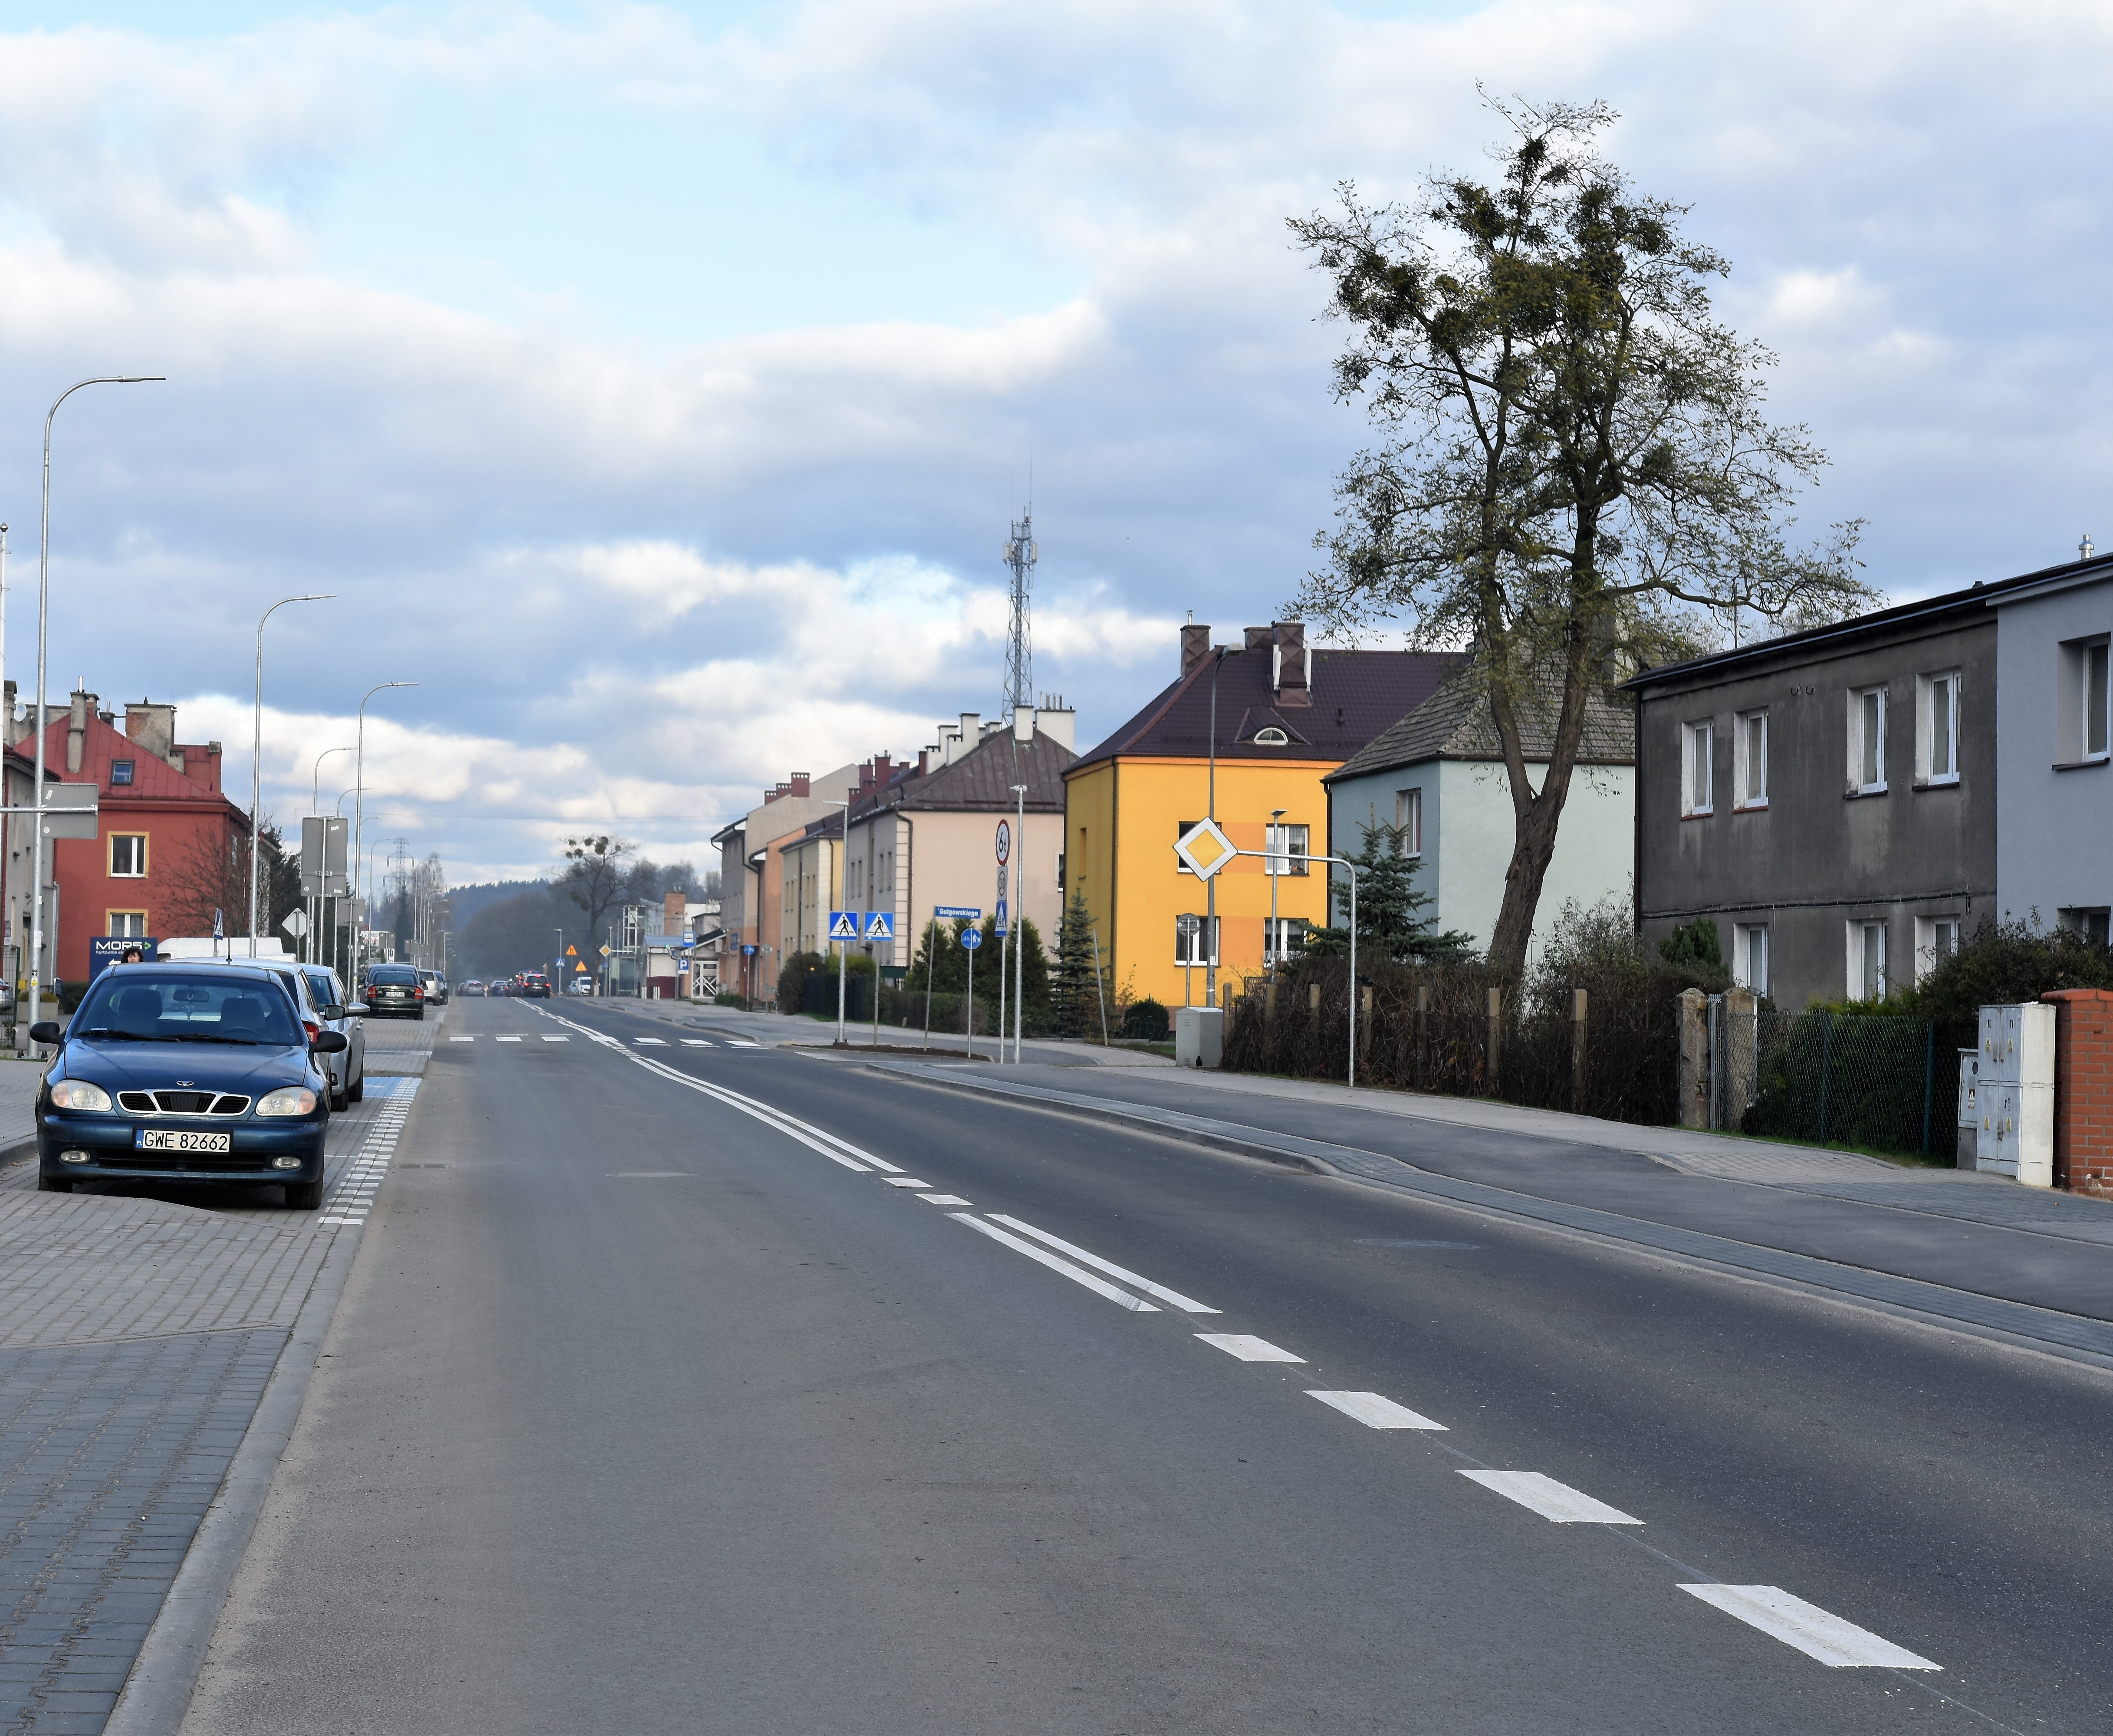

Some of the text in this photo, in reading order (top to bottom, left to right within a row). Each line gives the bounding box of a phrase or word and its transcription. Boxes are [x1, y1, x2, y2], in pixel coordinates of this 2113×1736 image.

[939, 908, 978, 917] Gulgowskiego
[96, 941, 142, 950] MORS
[680, 960, 687, 969] P
[145, 1132, 227, 1151] GWE 82662
